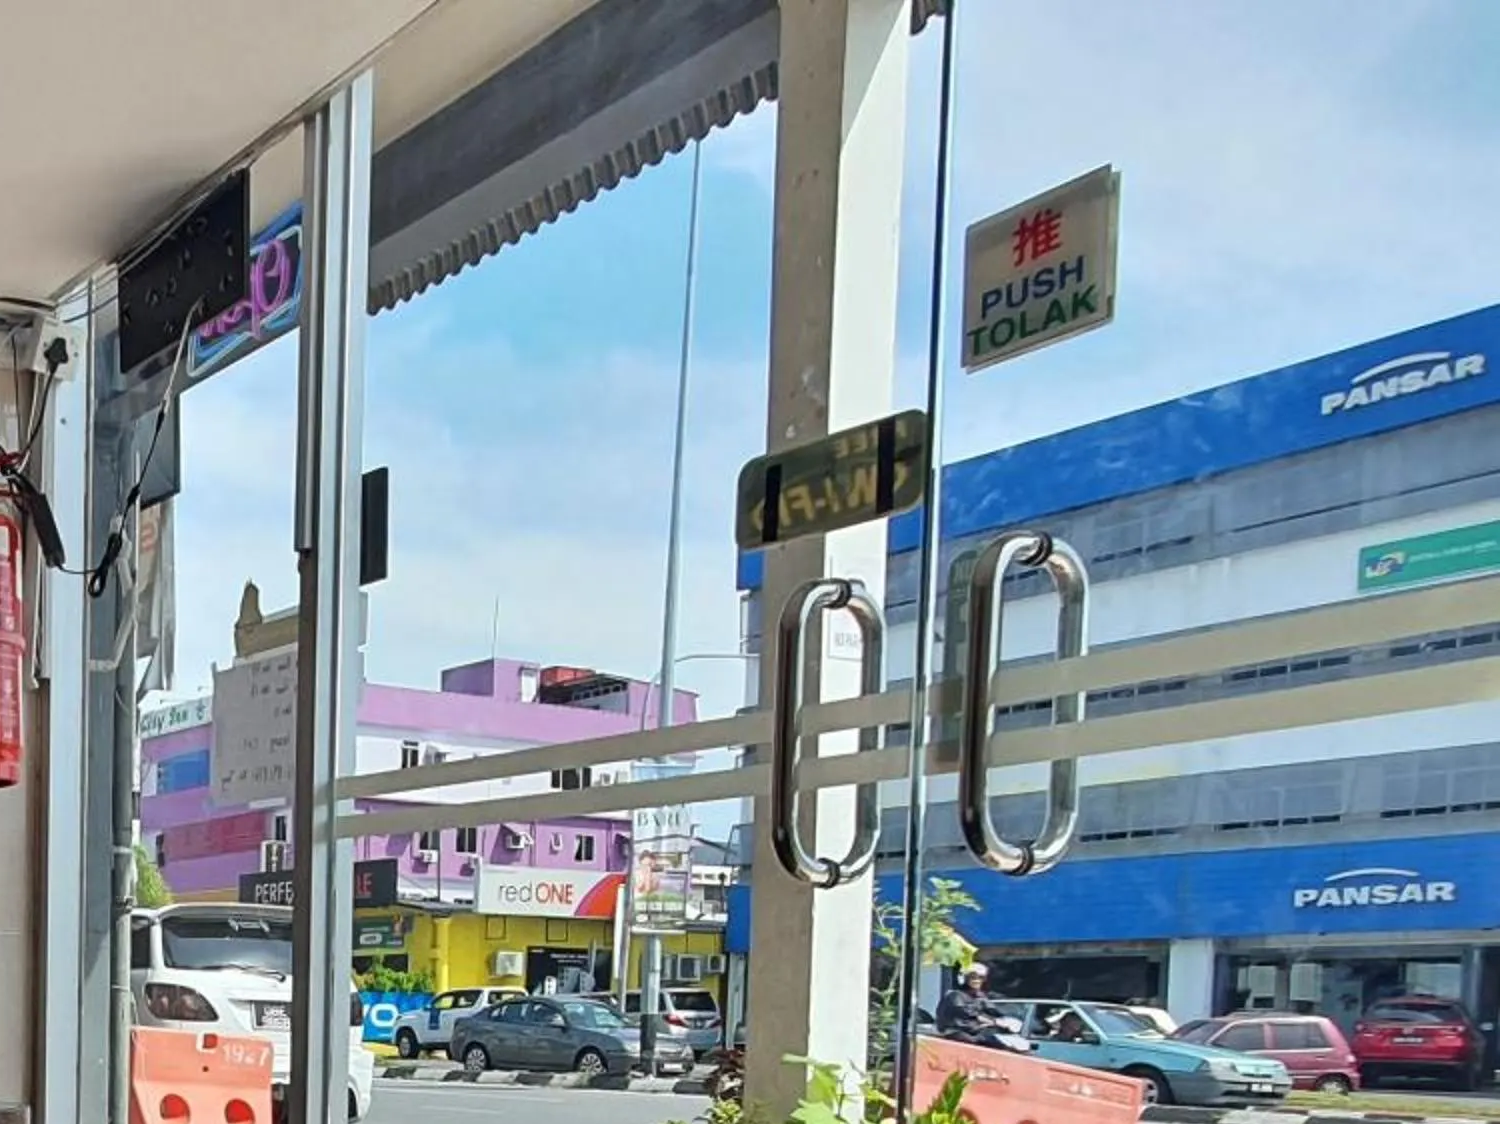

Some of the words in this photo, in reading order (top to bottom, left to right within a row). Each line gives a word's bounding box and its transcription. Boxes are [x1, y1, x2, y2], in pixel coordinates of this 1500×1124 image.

[1012, 208, 1068, 267] 推
[981, 255, 1085, 320] PUSH
[967, 284, 1097, 357] TOLAK
[1320, 353, 1487, 416] PANSAR
[254, 881, 294, 904] PERFE
[498, 881, 573, 905] redONE
[1293, 880, 1457, 909] PANSAR
